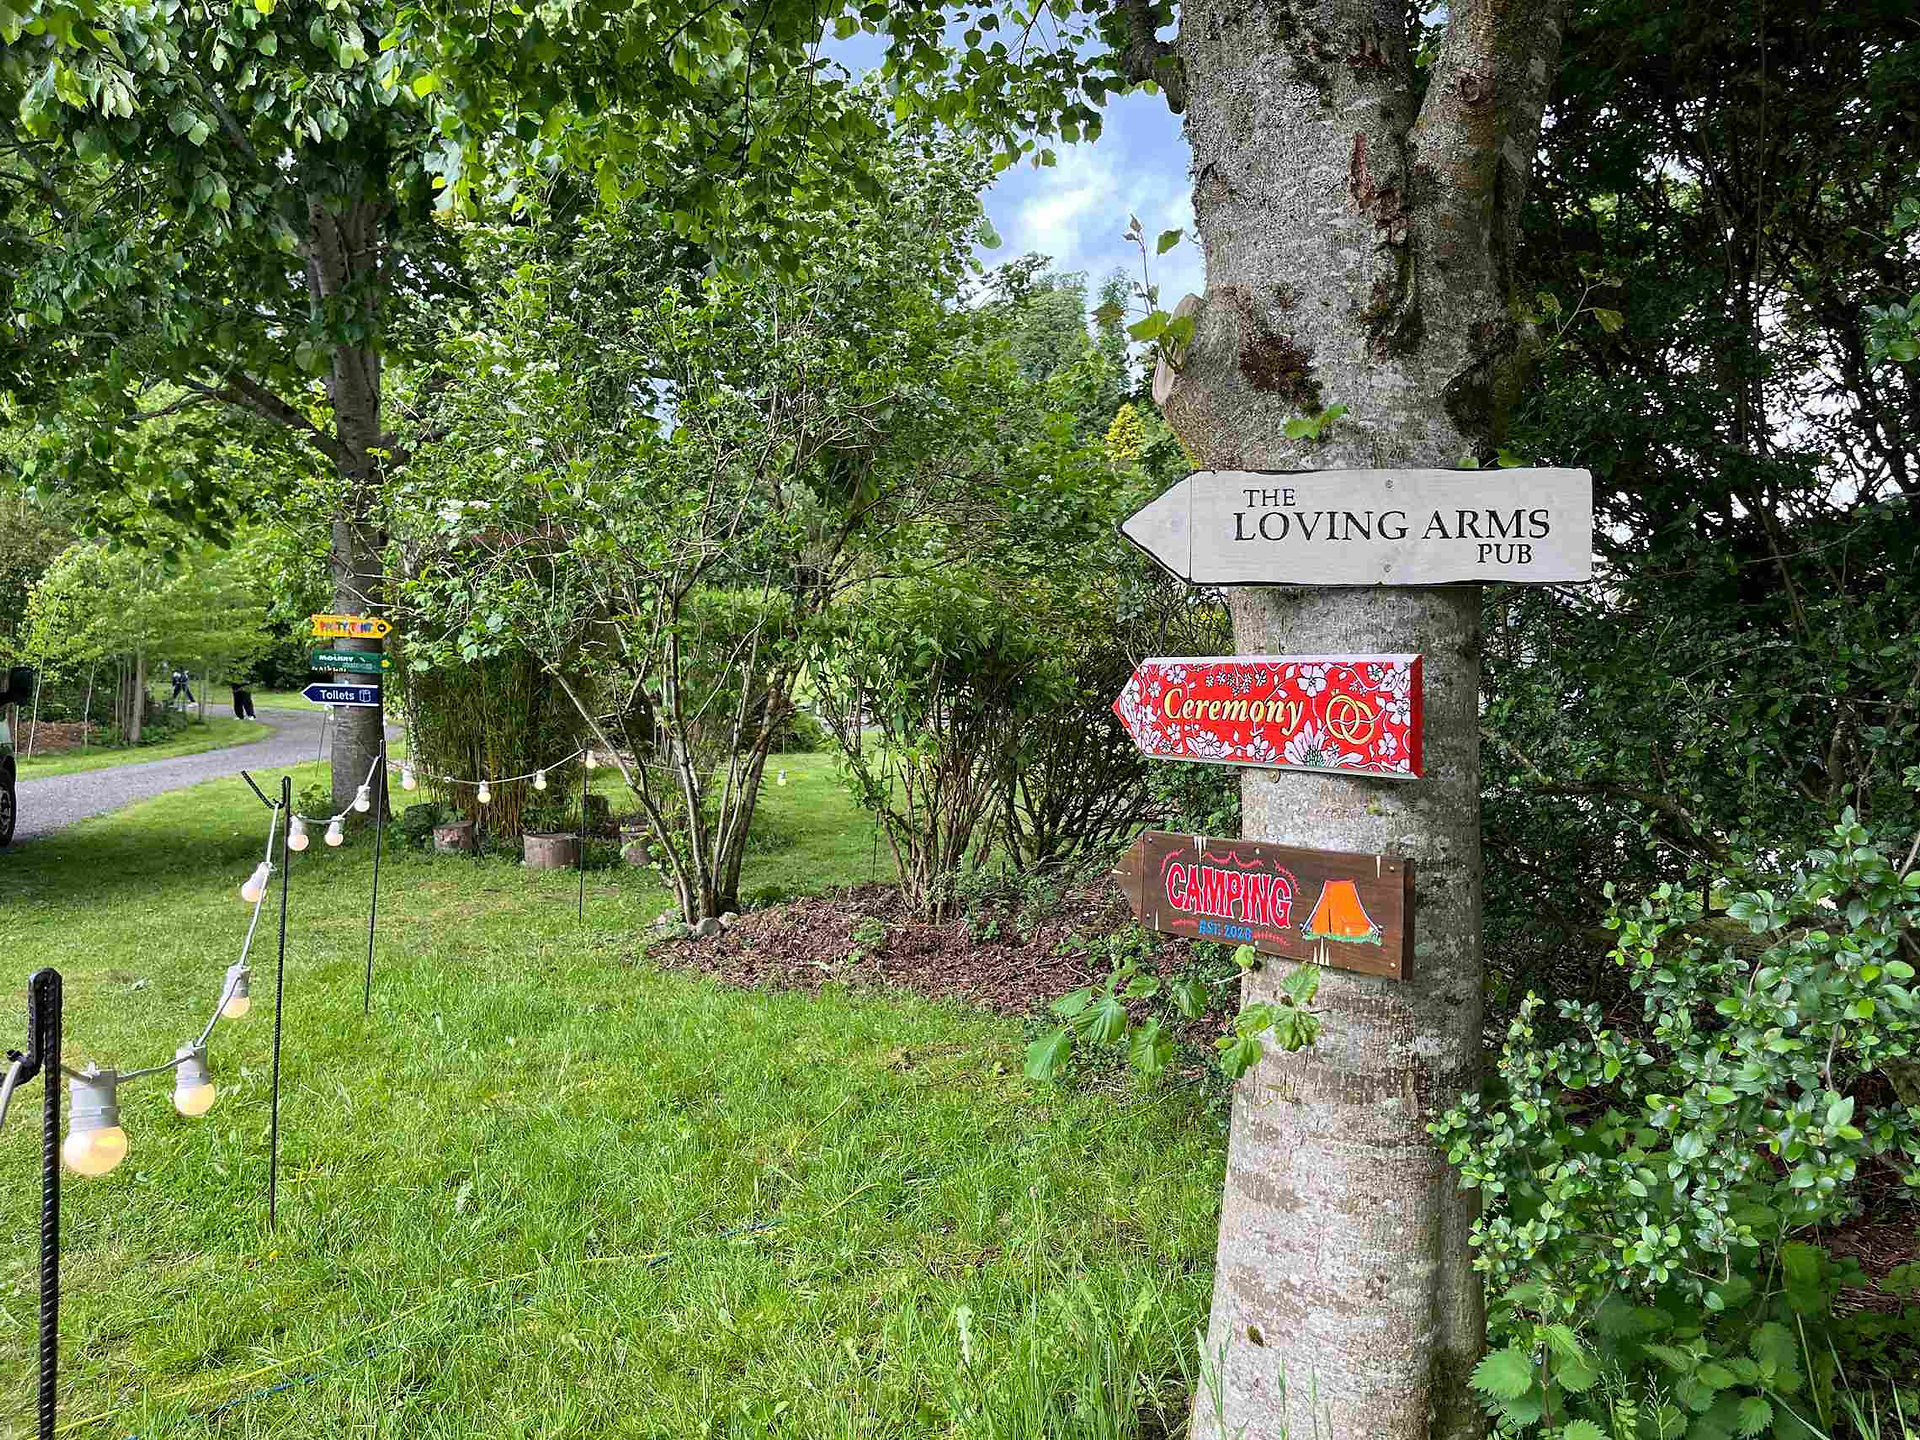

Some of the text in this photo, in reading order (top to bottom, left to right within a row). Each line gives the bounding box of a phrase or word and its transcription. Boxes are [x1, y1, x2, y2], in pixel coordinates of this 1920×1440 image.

[1243, 489, 1296, 508] THE
[1233, 508, 1550, 541] LOVING ARMS
[1476, 543, 1533, 564] PUB
[320, 689, 355, 700] Toilets
[1163, 688, 1304, 736] Ceremony
[1166, 862, 1293, 929] CAMPING
